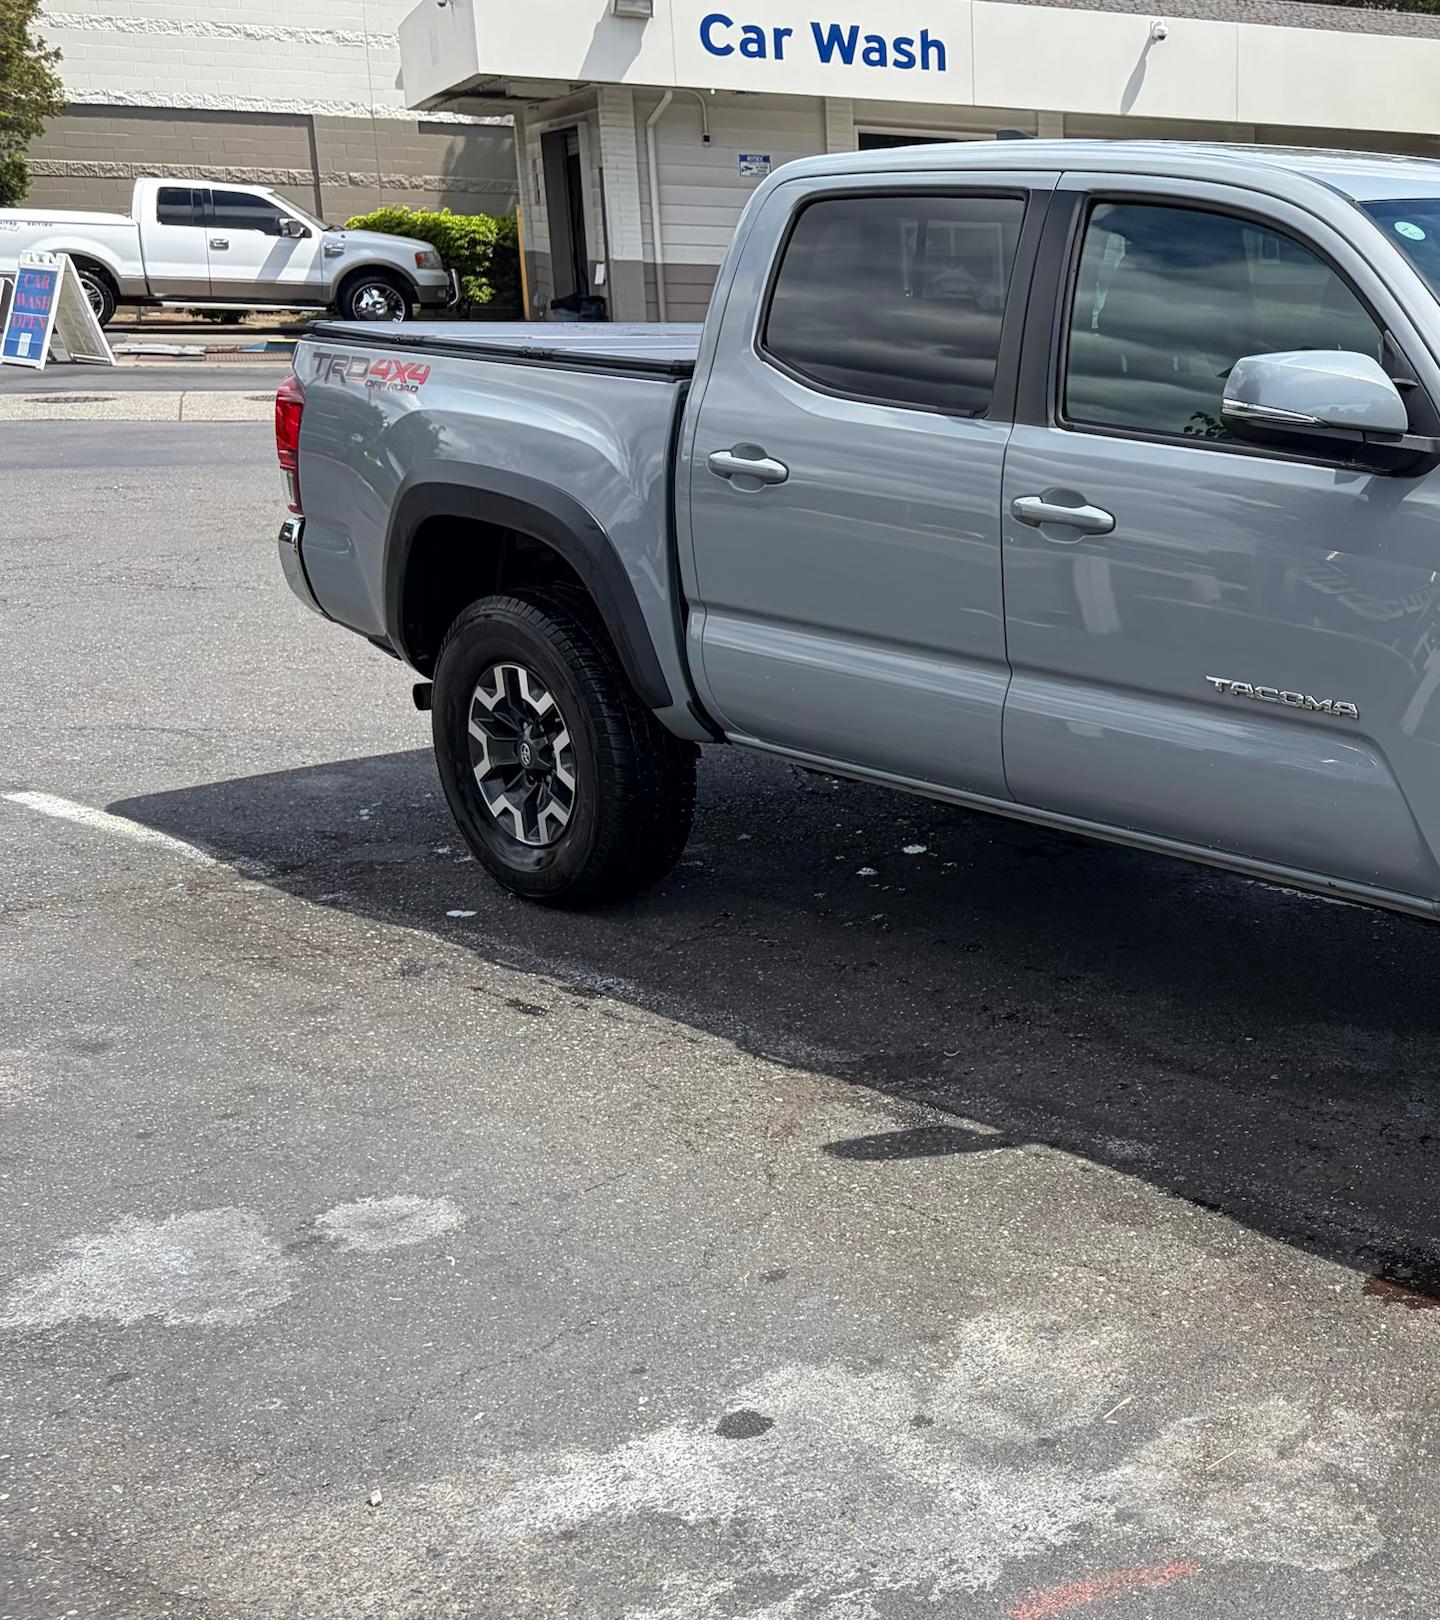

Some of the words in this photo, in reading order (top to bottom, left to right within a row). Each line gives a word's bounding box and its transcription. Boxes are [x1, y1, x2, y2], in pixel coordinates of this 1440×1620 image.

[700, 13, 793, 60] Car
[810, 22, 947, 72] Wash
[24, 275, 50, 289] CAR
[17, 293, 49, 310] WASH
[12, 314, 46, 329] OPEN
[312, 353, 371, 384] TRD
[365, 379, 387, 390] OFF
[388, 384, 419, 393] ROAD
[1205, 675, 1360, 720] TACOMA
